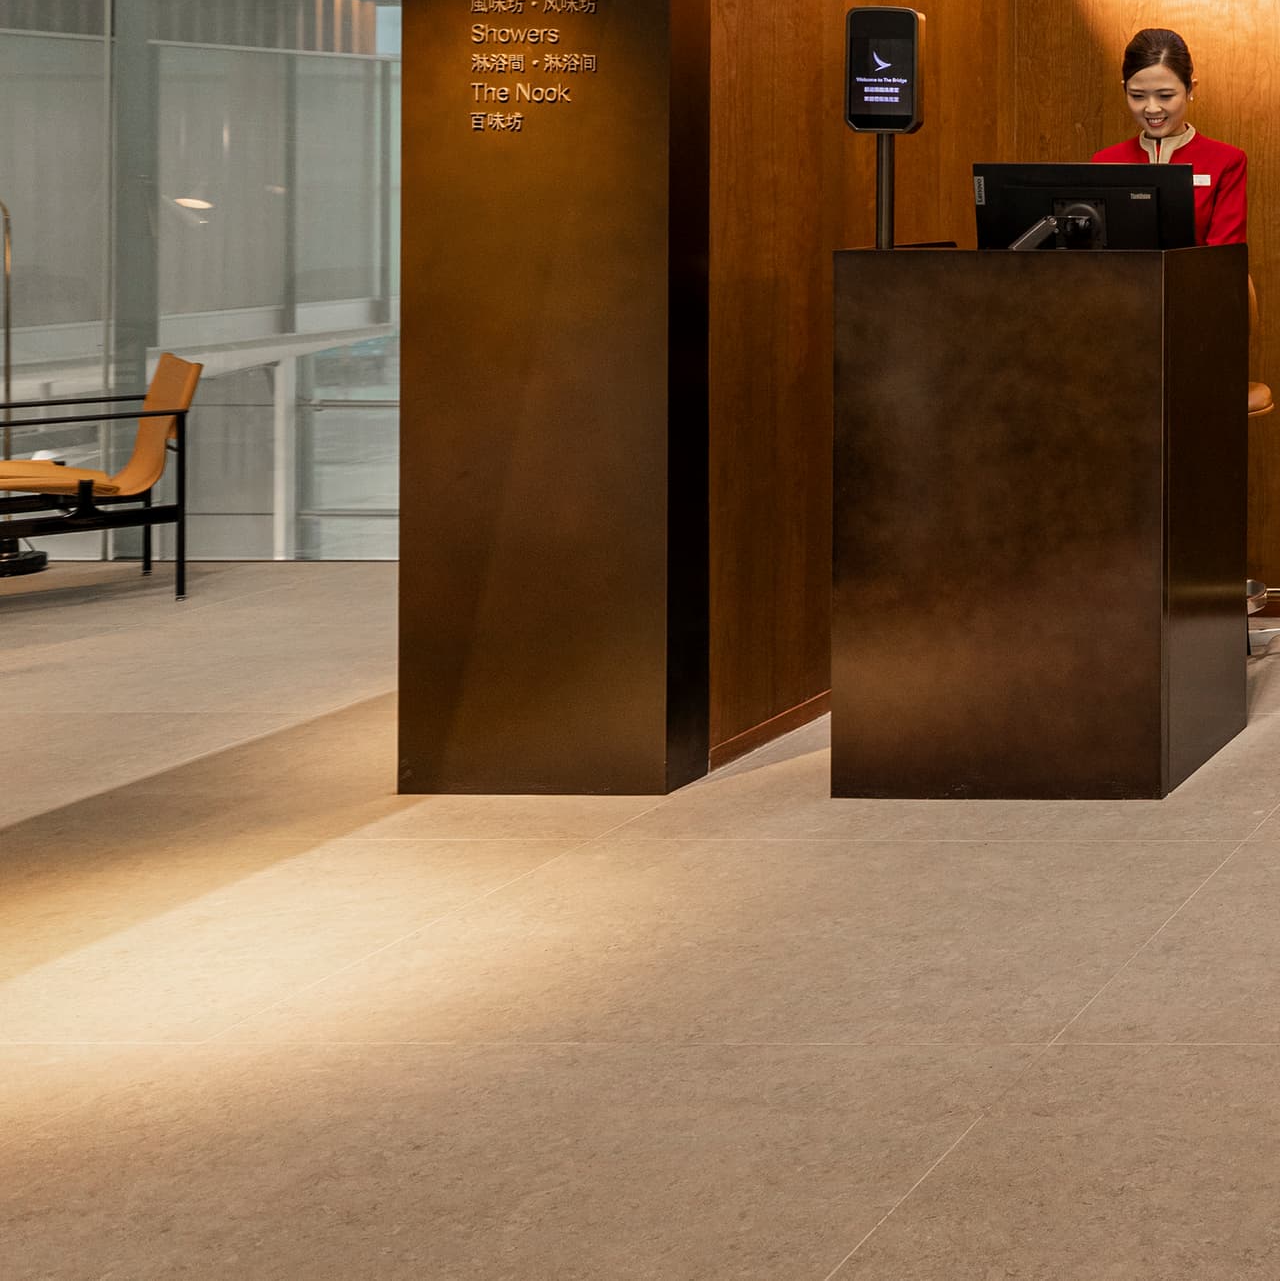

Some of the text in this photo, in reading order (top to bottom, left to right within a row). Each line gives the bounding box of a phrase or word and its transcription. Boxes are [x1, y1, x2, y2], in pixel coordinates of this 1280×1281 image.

[471, 23, 560, 43] Showers
[470, 82, 572, 102] The Nook
[470, 111, 524, 131] 百味坊
